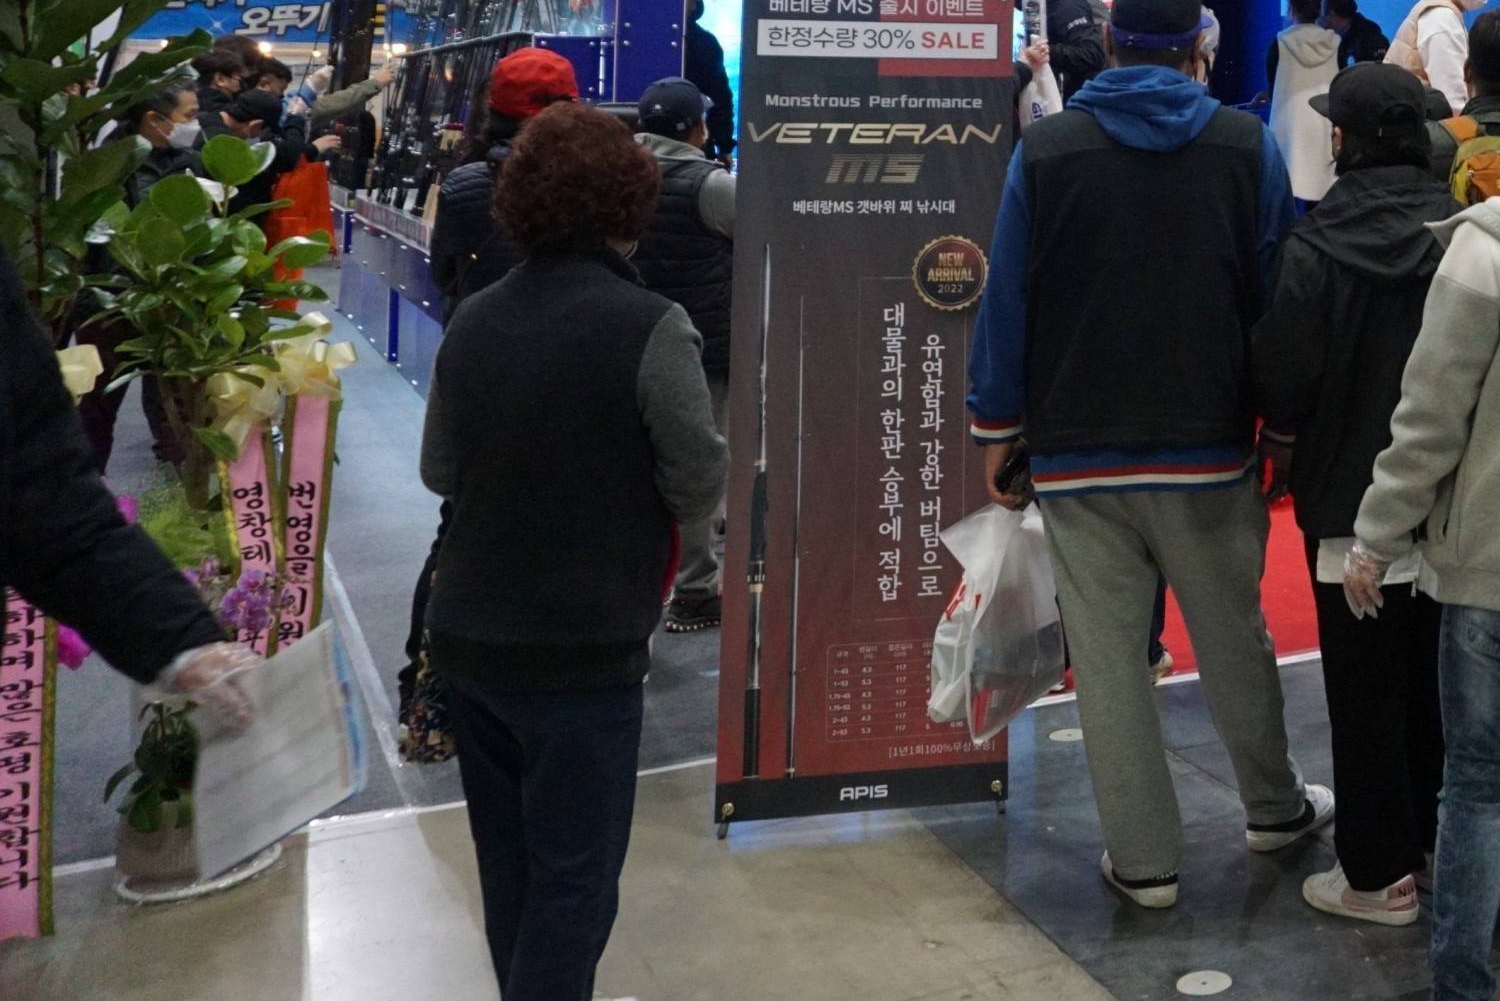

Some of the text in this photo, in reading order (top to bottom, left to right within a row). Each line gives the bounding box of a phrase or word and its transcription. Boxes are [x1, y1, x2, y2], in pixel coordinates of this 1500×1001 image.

[926, 0, 984, 17] 이벤트
[768, 25, 985, 49] 한정수량 30% SALE
[765, 94, 983, 109] Monstrous Performance
[747, 122, 1002, 145] VETERAN
[825, 154, 924, 184] MS
[793, 200, 956, 215] 베테랑MS 갯바위 찌 낚시대
[938, 252, 964, 267] NEW
[927, 268, 975, 283] ARRIVAL
[937, 284, 964, 295] 2022
[877, 302, 906, 602] 대물과의 한판 승부에 적합
[917, 334, 945, 598] 유연함과 강한 버팀으로
[840, 784, 888, 801] APIS
